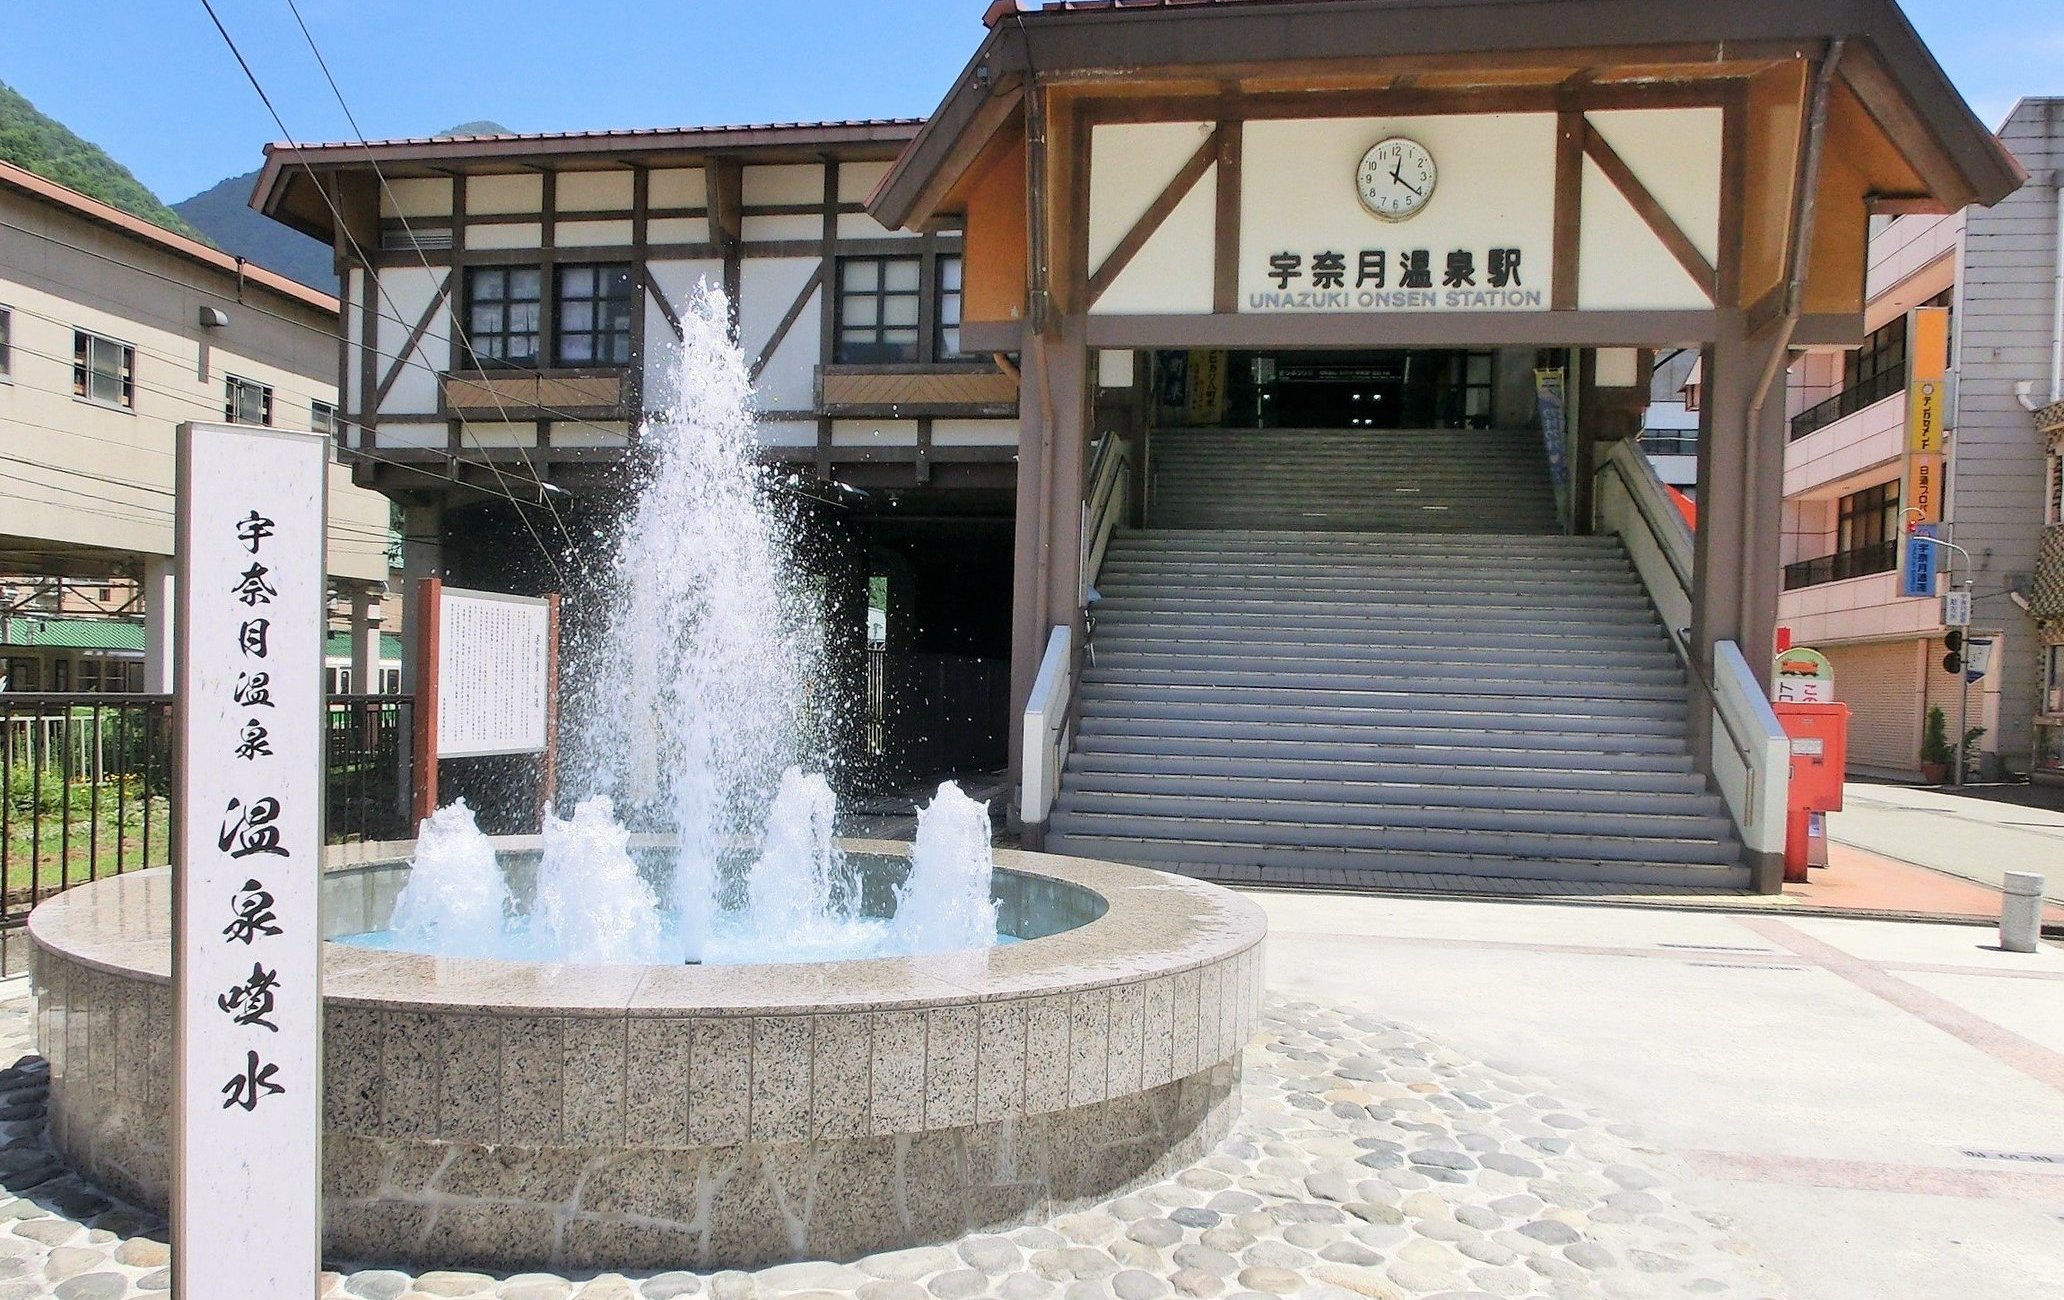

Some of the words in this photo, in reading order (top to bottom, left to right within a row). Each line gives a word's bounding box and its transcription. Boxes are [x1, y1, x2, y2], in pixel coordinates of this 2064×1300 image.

[1379, 150, 1387, 160] 11
[1391, 146, 1402, 157] 12
[1368, 161, 1377, 171] 10
[1417, 158, 1424, 168] 2
[1366, 174, 1372, 184] 9
[1420, 171, 1427, 181] 3
[1369, 188, 1376, 198] 8
[1380, 197, 1387, 207] 7
[1392, 199, 1399, 209] 6
[1406, 195, 1412, 205] 5
[1268, 248, 1522, 289] 宇奈月温泉駅
[1249, 292, 1349, 309] UNAZUKI
[1357, 291, 1437, 308] ONSEN
[1445, 290, 1542, 308] STATION
[231, 510, 278, 761] 宇奈月温泉
[217, 796, 290, 1112] 温泉噴水
